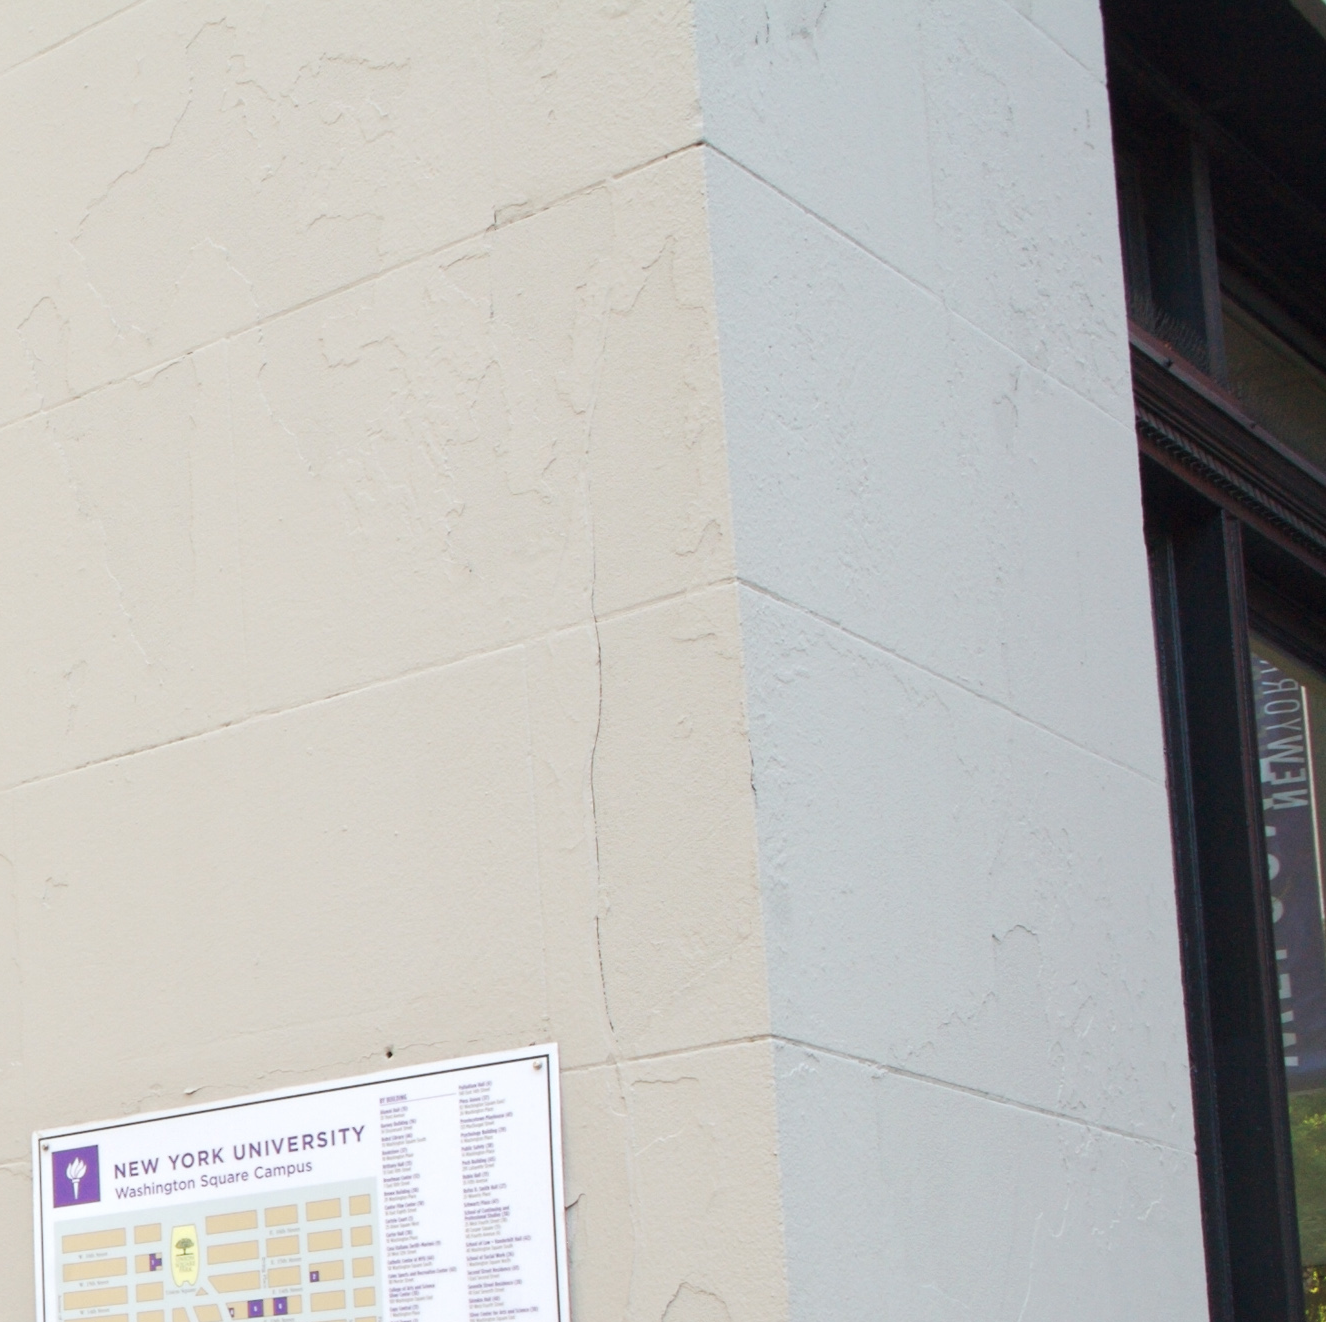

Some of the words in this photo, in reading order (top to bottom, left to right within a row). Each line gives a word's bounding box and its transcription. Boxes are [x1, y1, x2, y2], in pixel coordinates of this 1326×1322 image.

[114, 1157, 159, 1179] NEW
[169, 1147, 224, 1171] YORK
[233, 1125, 366, 1162] UNIVERSITY
[115, 1177, 195, 1199] Washington
[200, 1172, 249, 1189] Square
[254, 1161, 312, 1180] Campus
